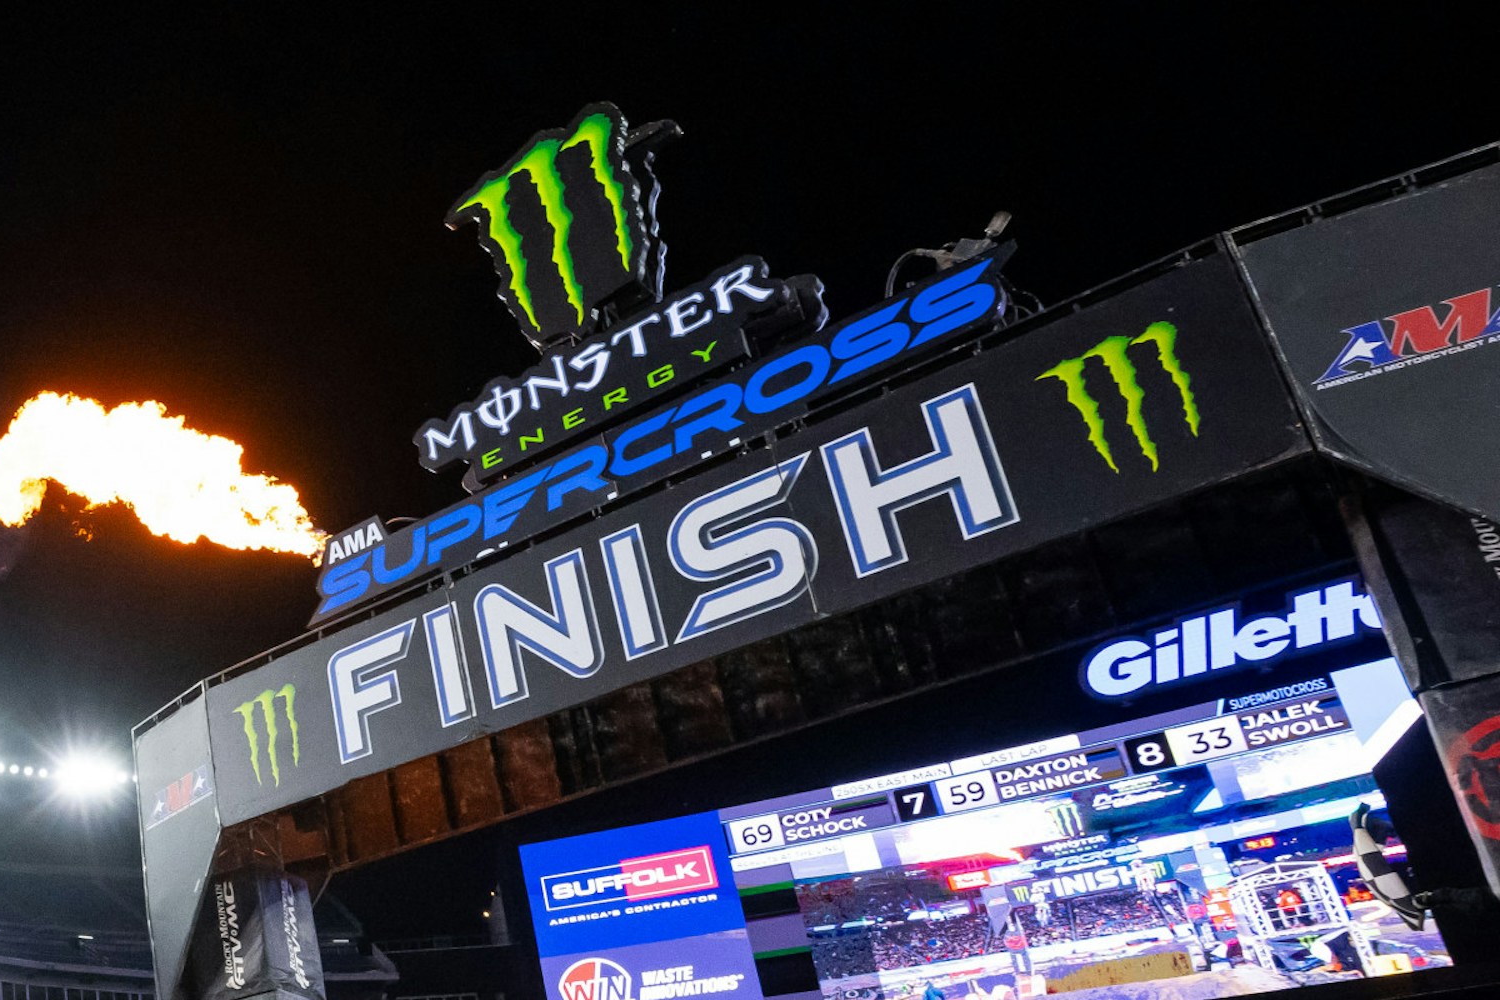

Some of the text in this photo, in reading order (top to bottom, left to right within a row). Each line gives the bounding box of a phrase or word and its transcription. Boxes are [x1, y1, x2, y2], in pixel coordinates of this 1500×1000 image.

[423, 263, 774, 460] MONSTER
[1316, 368, 1383, 390] AMERICAN
[1384, 339, 1485, 373] MOTORCYCLIST
[481, 340, 717, 470] ENERGY
[319, 258, 995, 614] SUPERCROSS
[328, 522, 384, 565] AMA
[328, 383, 1020, 764] FINISH
[1229, 678, 1327, 711] SUPERMOTOCROSS
[1136, 700, 1324, 766] 8 33 JALEK
[1249, 716, 1344, 746] SWOLL
[980, 744, 1048, 767] LAST LAP
[902, 754, 1088, 815] 7 59 DAXTON
[1000, 767, 1103, 800] BENNICK
[741, 807, 833, 847] 69 COTY
[785, 815, 867, 842] SCHOCK
[551, 861, 700, 900] SUFFOLK
[214, 884, 233, 974] ROCKY MOUNTAIN
[549, 894, 718, 926] AMERICA'S CONTRACTOR
[641, 965, 693, 986] WASTE
